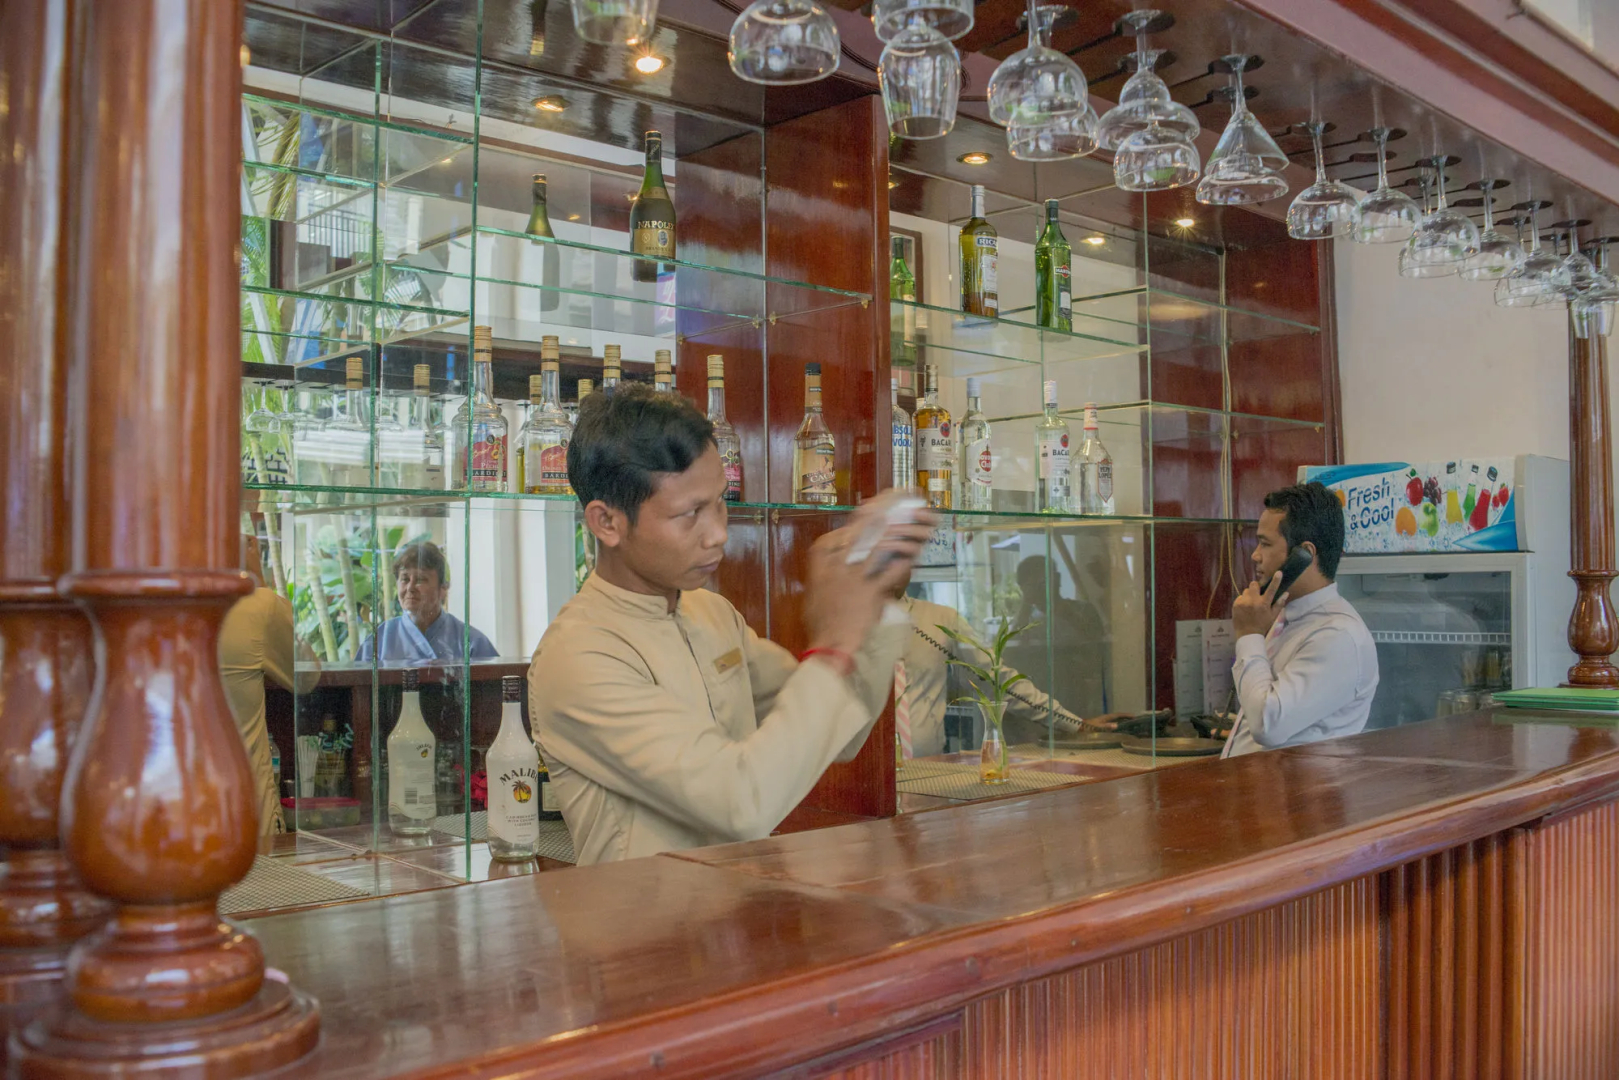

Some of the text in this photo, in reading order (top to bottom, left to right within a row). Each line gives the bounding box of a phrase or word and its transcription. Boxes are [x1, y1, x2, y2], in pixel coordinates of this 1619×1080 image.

[1348, 477, 1390, 510] Fresh
[1350, 497, 1394, 530] & Cool
